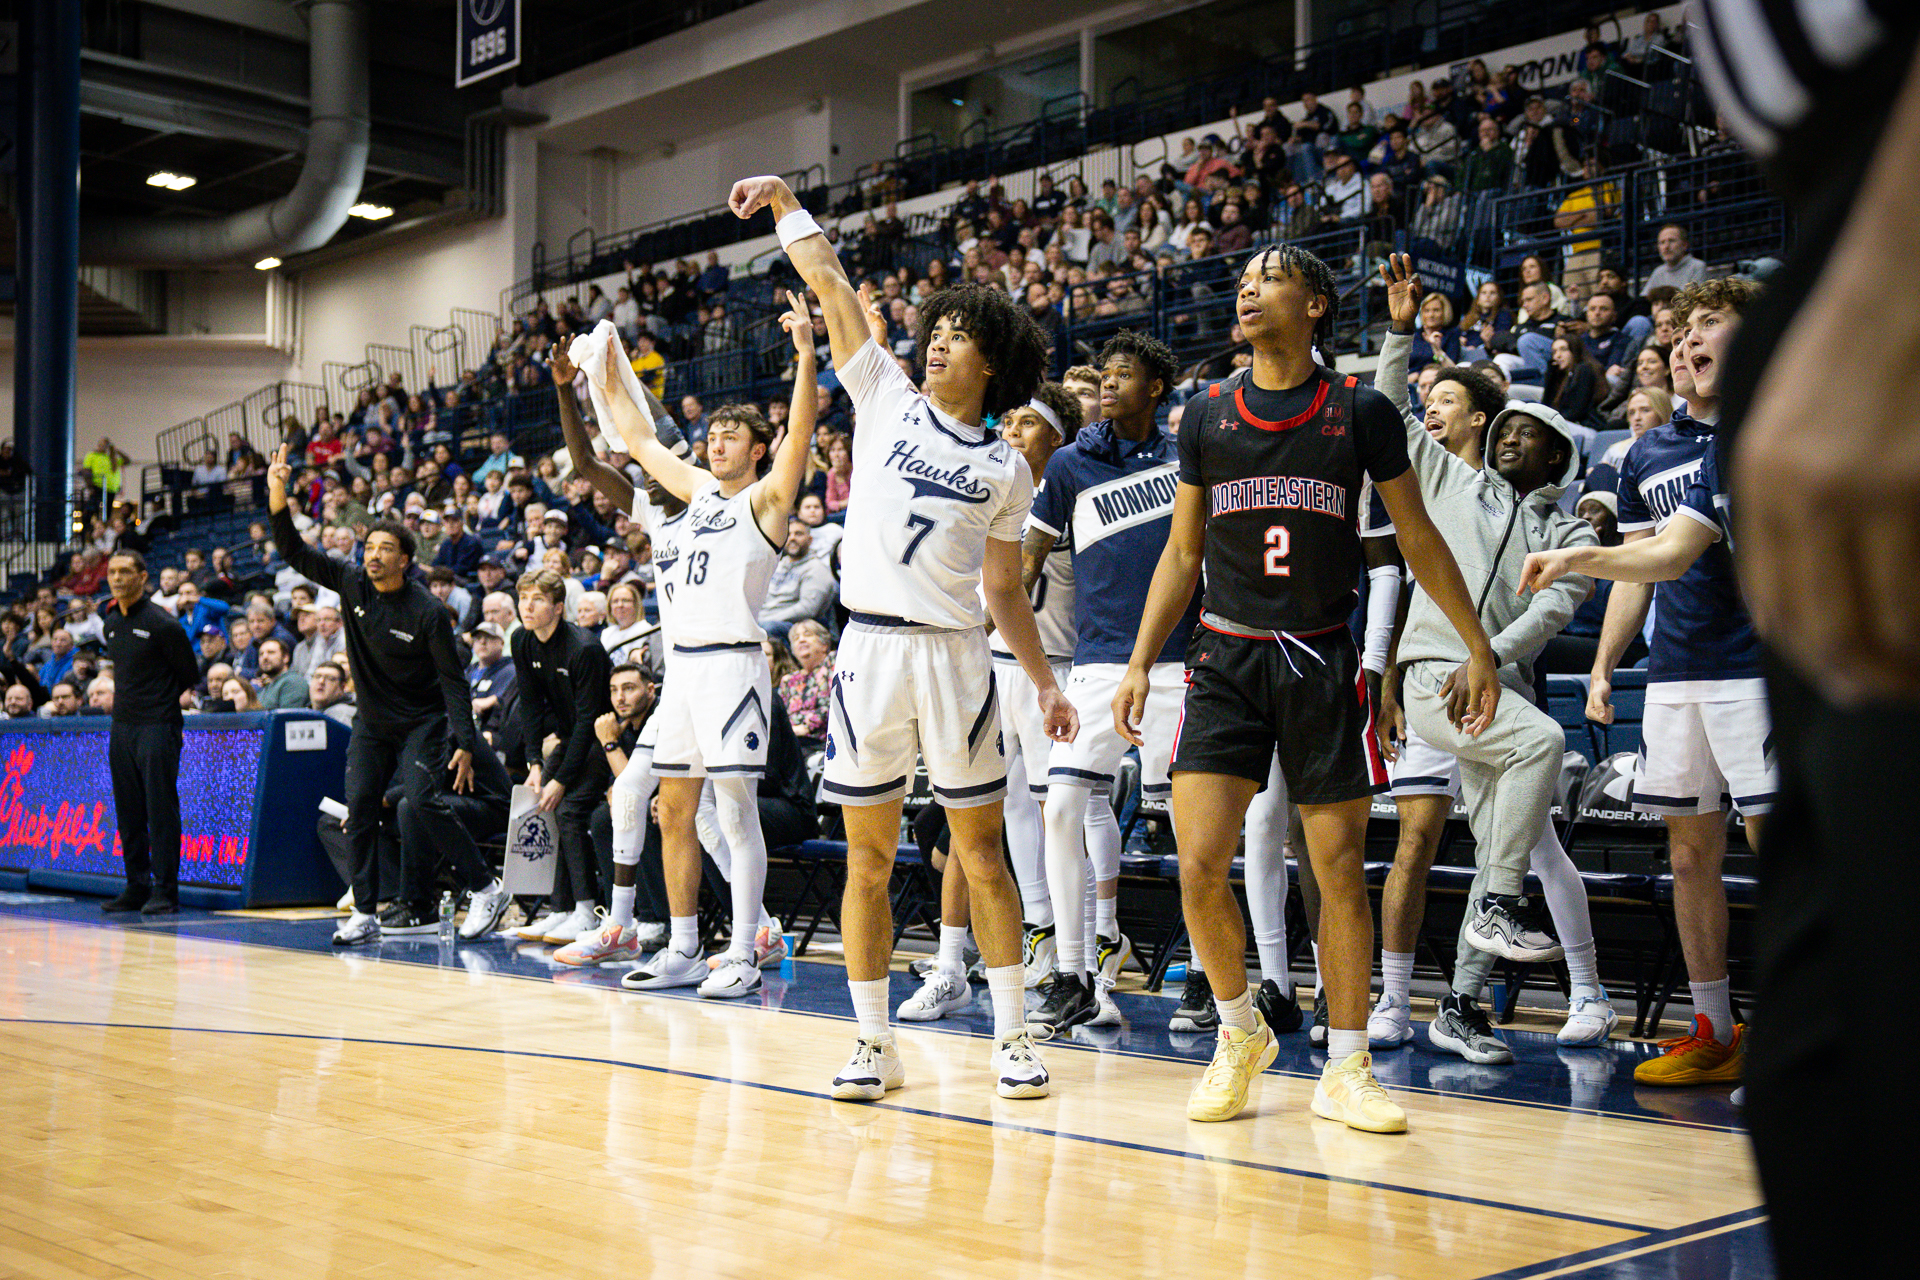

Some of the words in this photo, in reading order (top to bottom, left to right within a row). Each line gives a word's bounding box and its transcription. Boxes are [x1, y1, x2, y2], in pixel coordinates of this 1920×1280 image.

[470, 26, 507, 67] 1996
[1321, 424, 1346, 437] CAA
[1324, 406, 1342, 418] BLM
[884, 440, 981, 495] Hawks
[988, 453, 1003, 465] CAA
[1212, 475, 1346, 521] NORTHEASTERN
[899, 510, 939, 568] 7
[1264, 525, 1291, 577] 2
[686, 550, 710, 586] 13
[0, 769, 106, 860] Chick-fil-A
[1582, 807, 1635, 821] UNDER
